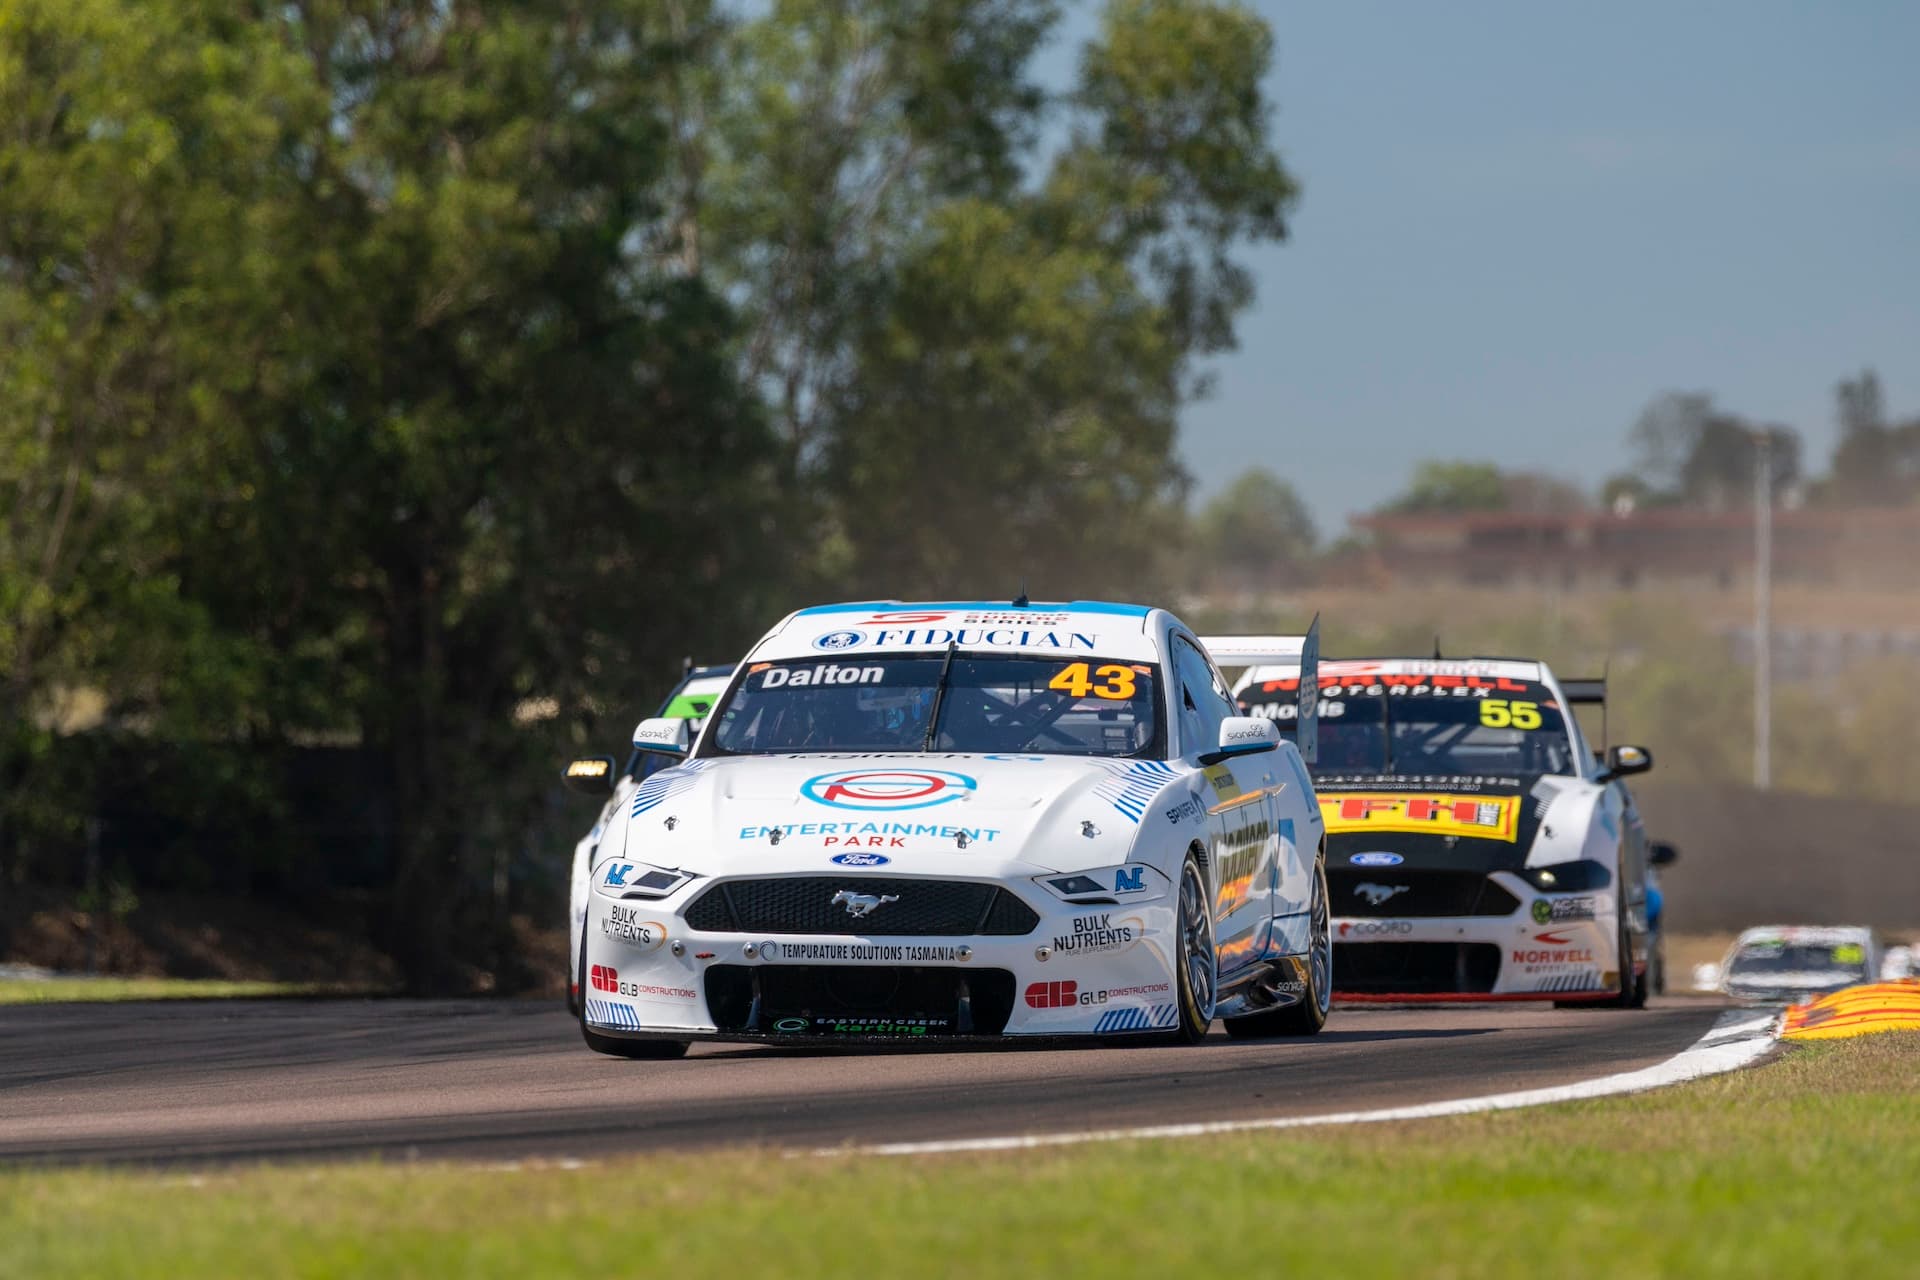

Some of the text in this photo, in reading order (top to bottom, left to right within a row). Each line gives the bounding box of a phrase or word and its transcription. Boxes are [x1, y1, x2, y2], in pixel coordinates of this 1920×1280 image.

[873, 629, 1099, 650] FIDUCIAN
[761, 664, 885, 688] Dalton
[1049, 662, 1137, 699] 43
[1250, 699, 1346, 720] Mois
[1480, 699, 1543, 730] 55
[740, 821, 1001, 843] ENTERTAINMENT
[824, 836, 905, 848] PARK
[612, 905, 638, 926] BULK
[1073, 914, 1111, 934] BULK
[602, 917, 651, 944] NUTRIENTS
[1053, 927, 1131, 952] NUTRIENTS
[783, 944, 956, 961] TEMPURATURE SOLUTIONS TASMANIA
[1513, 950, 1594, 963] NORWELL
[620, 982, 640, 997] GLB
[1079, 983, 1169, 1005] GLB CONSTRUCTIONS
[834, 1024, 928, 1035] karting
